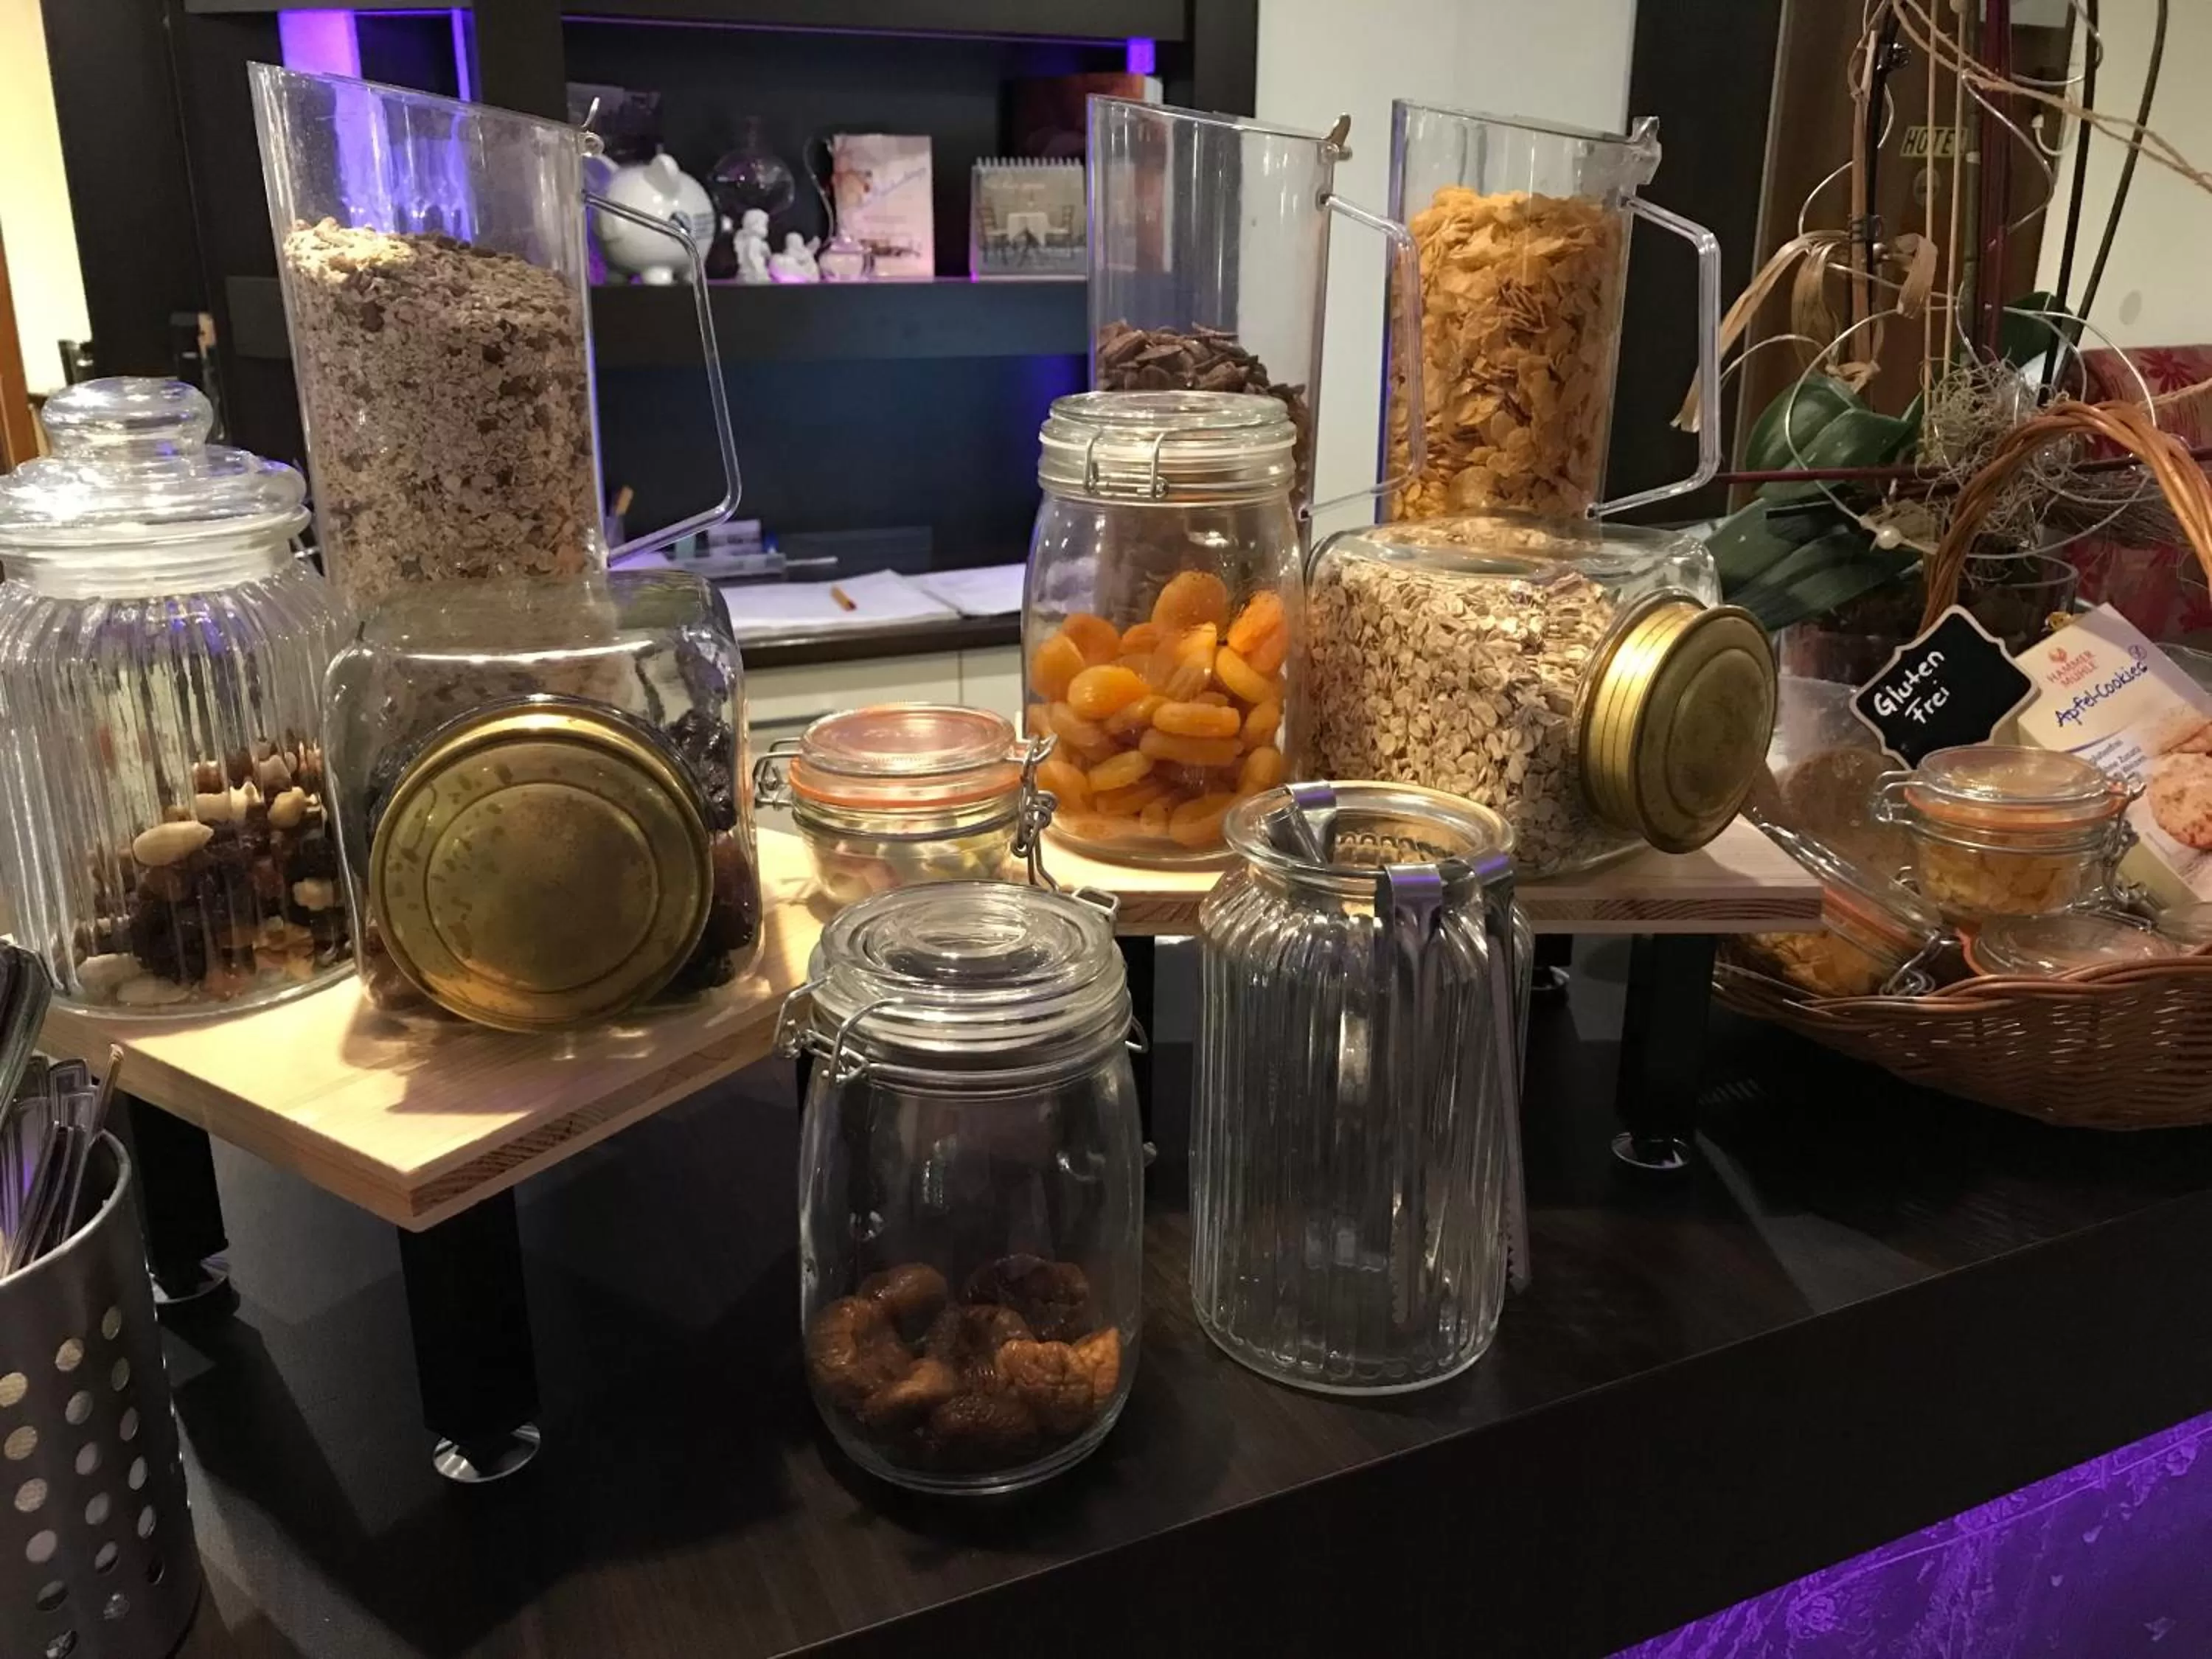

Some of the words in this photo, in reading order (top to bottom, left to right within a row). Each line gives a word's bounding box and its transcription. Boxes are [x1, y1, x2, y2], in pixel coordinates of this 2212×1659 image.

[1874, 651, 1945, 717] Gluten
[1905, 680, 1950, 724] Frei
[2055, 661, 2148, 728] Apfel-Cookies
